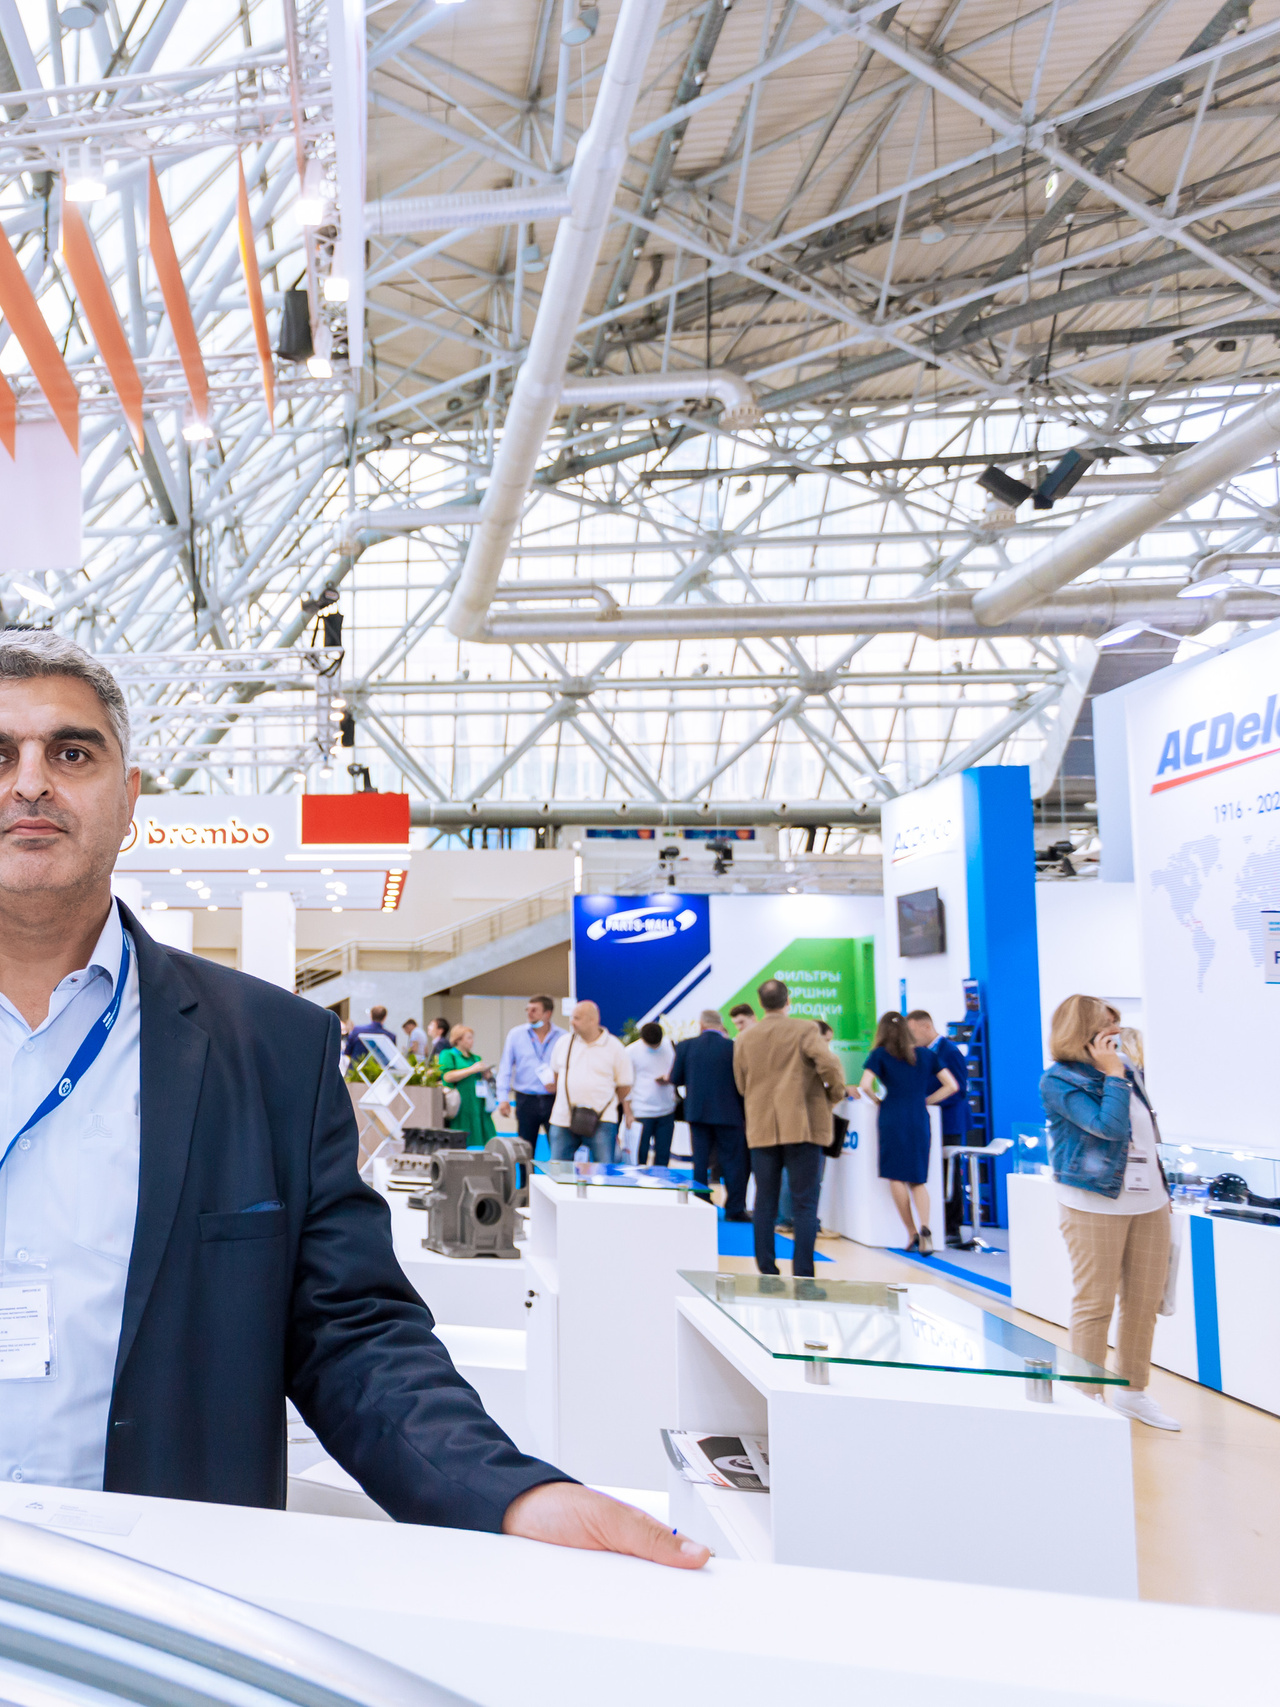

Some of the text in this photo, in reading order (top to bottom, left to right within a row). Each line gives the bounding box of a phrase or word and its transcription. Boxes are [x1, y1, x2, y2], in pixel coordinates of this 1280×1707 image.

[1156, 693, 1280, 776] ACDel
[1214, 801, 1242, 823] 1916
[148, 820, 270, 844] brembo
[773, 970, 842, 982] ФИЛЬТРЫ
[787, 986, 838, 998] ОРШНИ
[788, 1003, 844, 1018] ОЛОДКИ
